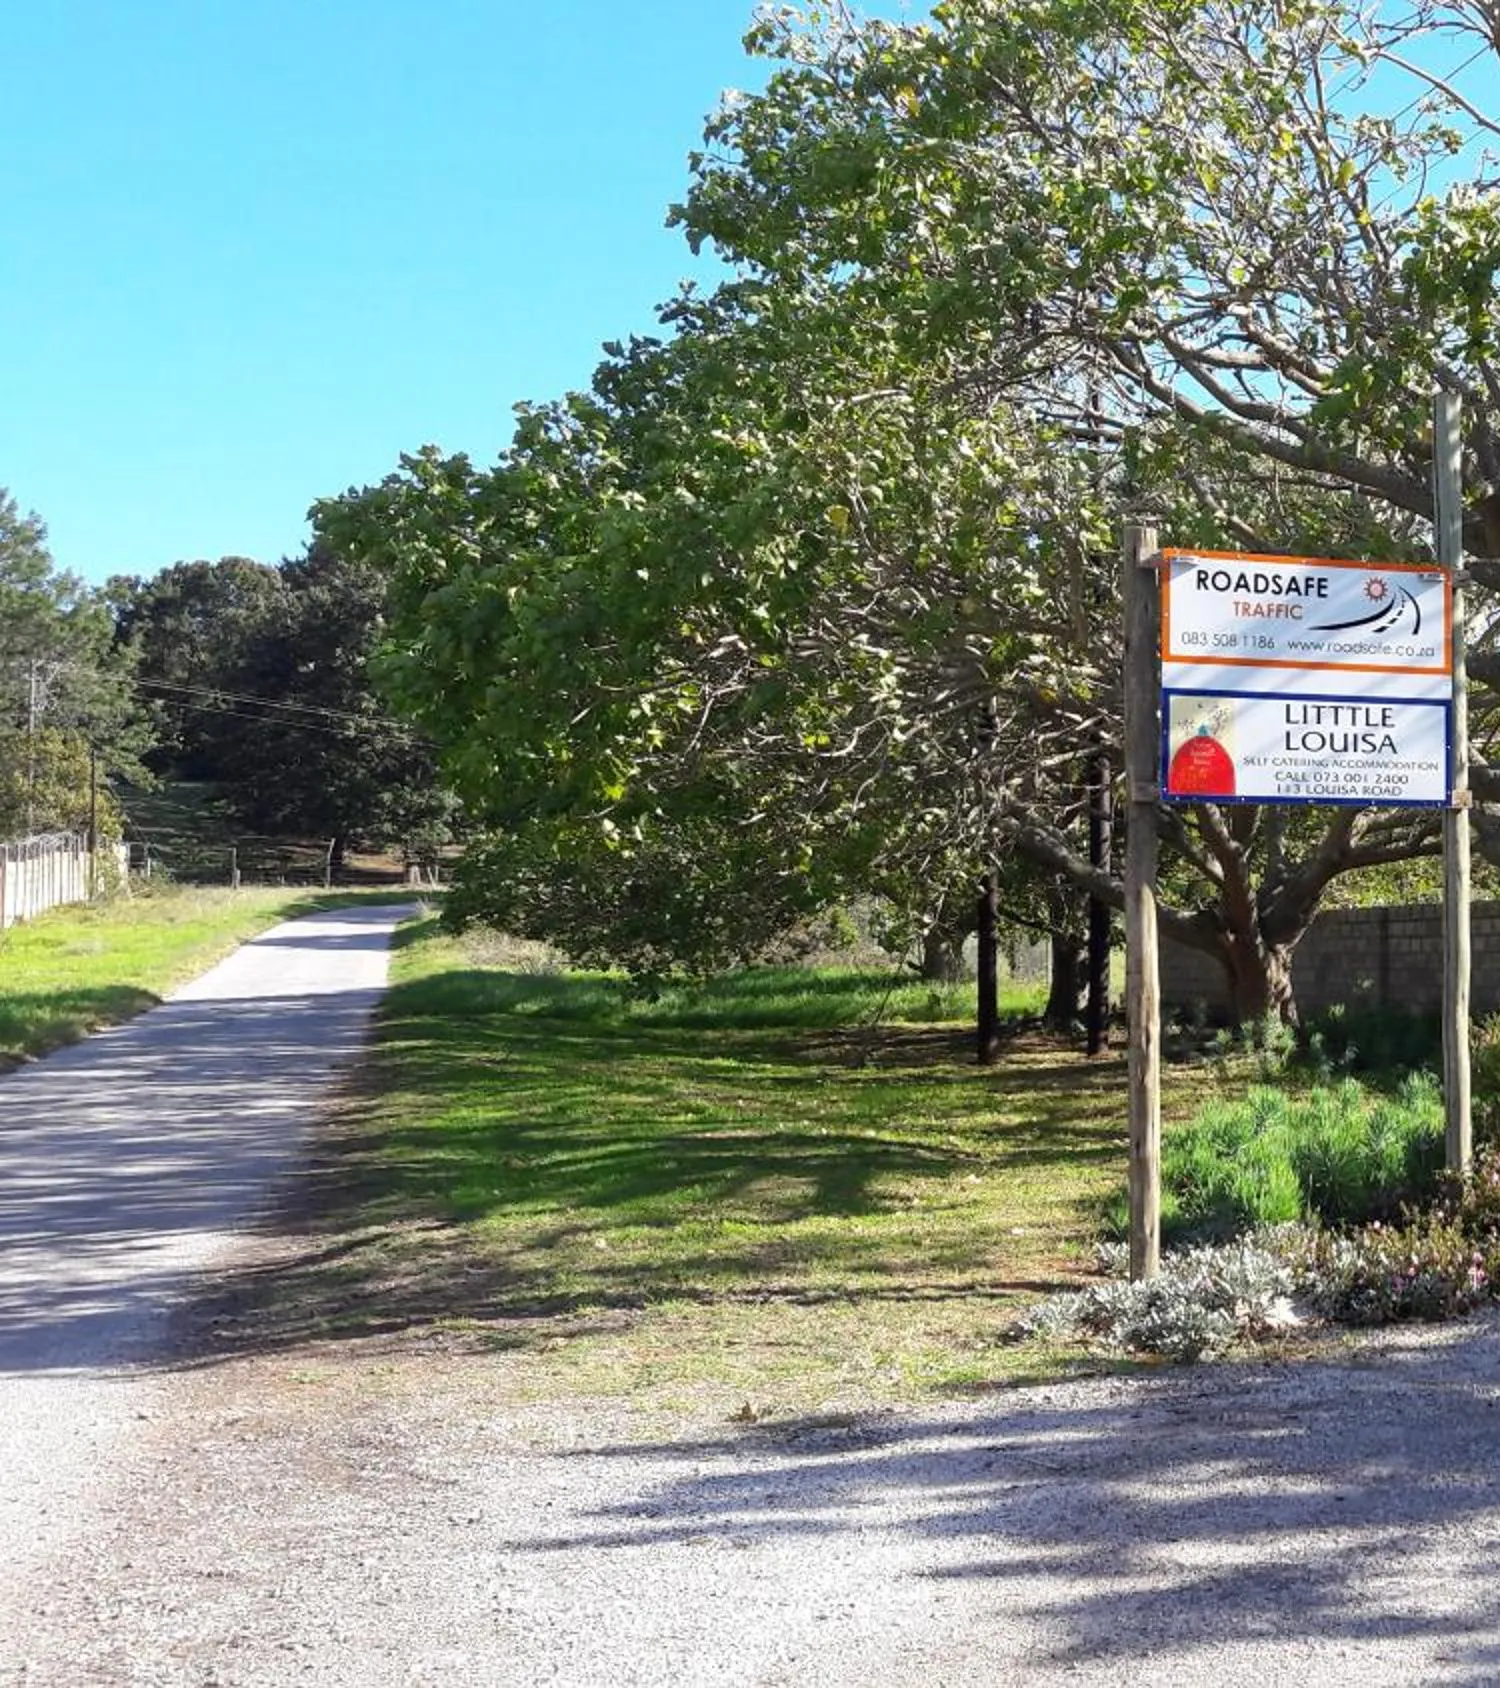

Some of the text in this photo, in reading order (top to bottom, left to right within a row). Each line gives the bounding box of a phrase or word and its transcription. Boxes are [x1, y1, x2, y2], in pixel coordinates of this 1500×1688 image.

[1196, 569, 1329, 598] ROADSAFE
[1232, 600, 1304, 620] TRAFFIC
[1181, 631, 1435, 657] 083 508 1186 www.roadsafe.co.za
[1285, 703, 1396, 727] LITTTLE
[1285, 730, 1398, 754] LOUISA
[1243, 757, 1268, 766] SELF
[1271, 757, 1329, 769] CATERING
[1274, 771, 1310, 782] CALL
[1313, 771, 1339, 782] 073
[1375, 773, 1409, 784] 2400
[1305, 783, 1359, 795] LOUISA
[1362, 785, 1403, 796] ROAD
